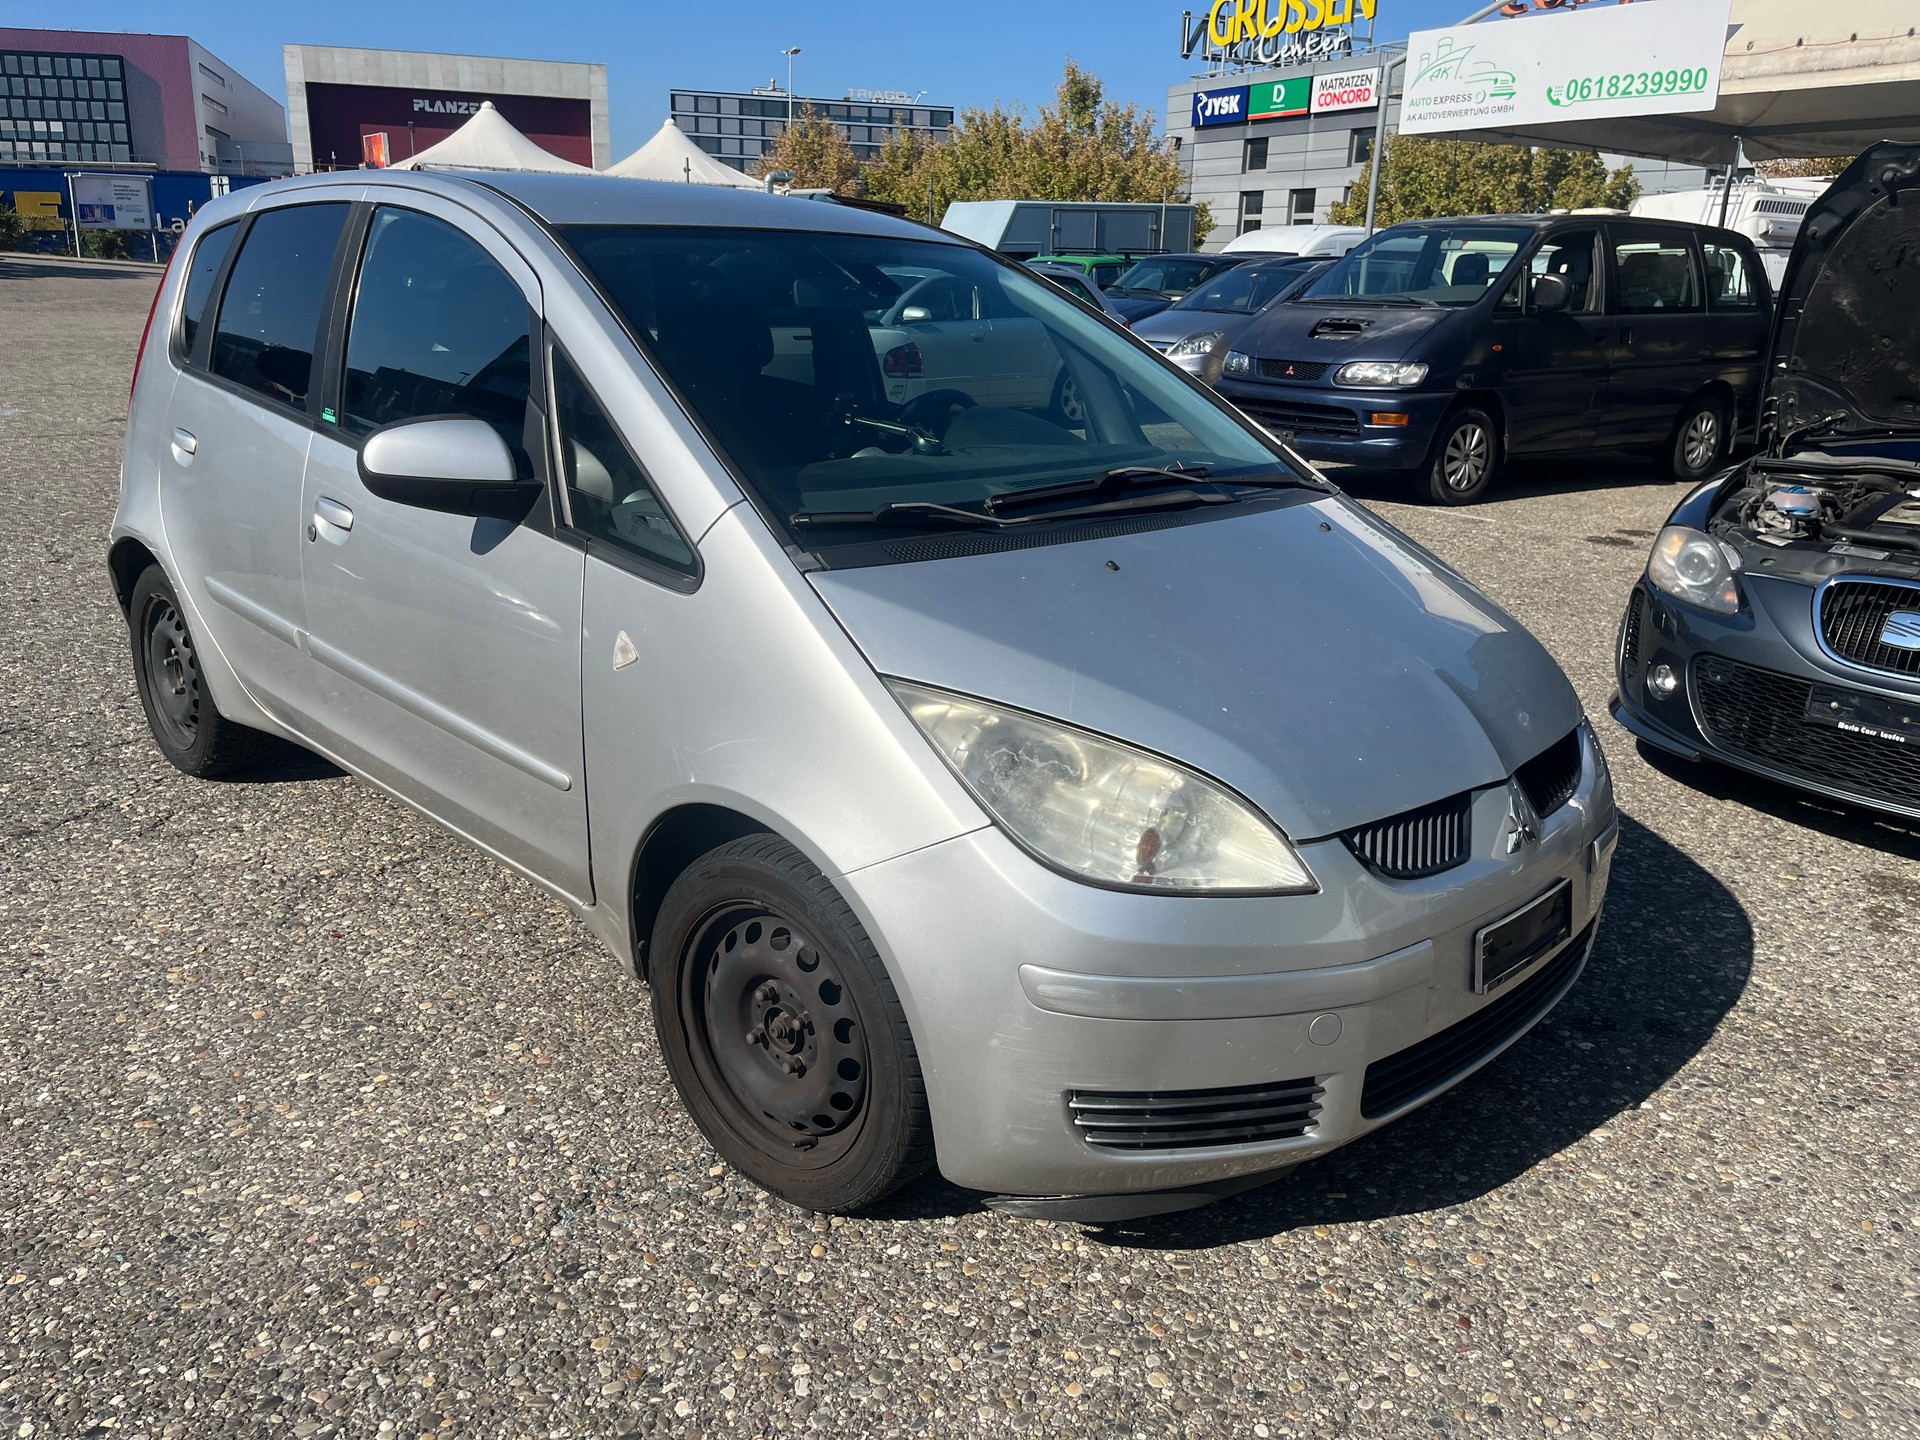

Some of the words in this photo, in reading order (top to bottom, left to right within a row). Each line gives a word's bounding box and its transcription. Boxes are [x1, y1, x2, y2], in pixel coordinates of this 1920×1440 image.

[1258, 16, 1350, 63] Center
[1319, 73, 1373, 91] MATRATZEN
[1566, 67, 1708, 100] 0618239990
[1272, 84, 1286, 103] D
[1317, 87, 1371, 107] CONCORD
[1409, 96, 1432, 108] AUTO
[1433, 93, 1473, 105] EXPRESS
[413, 98, 484, 115] PLANZE
[1204, 94, 1241, 117] JYSK
[1406, 113, 1417, 122] AK
[1418, 106, 1490, 121] AUTOVERWERTUNG
[1490, 104, 1515, 114] GMBH
